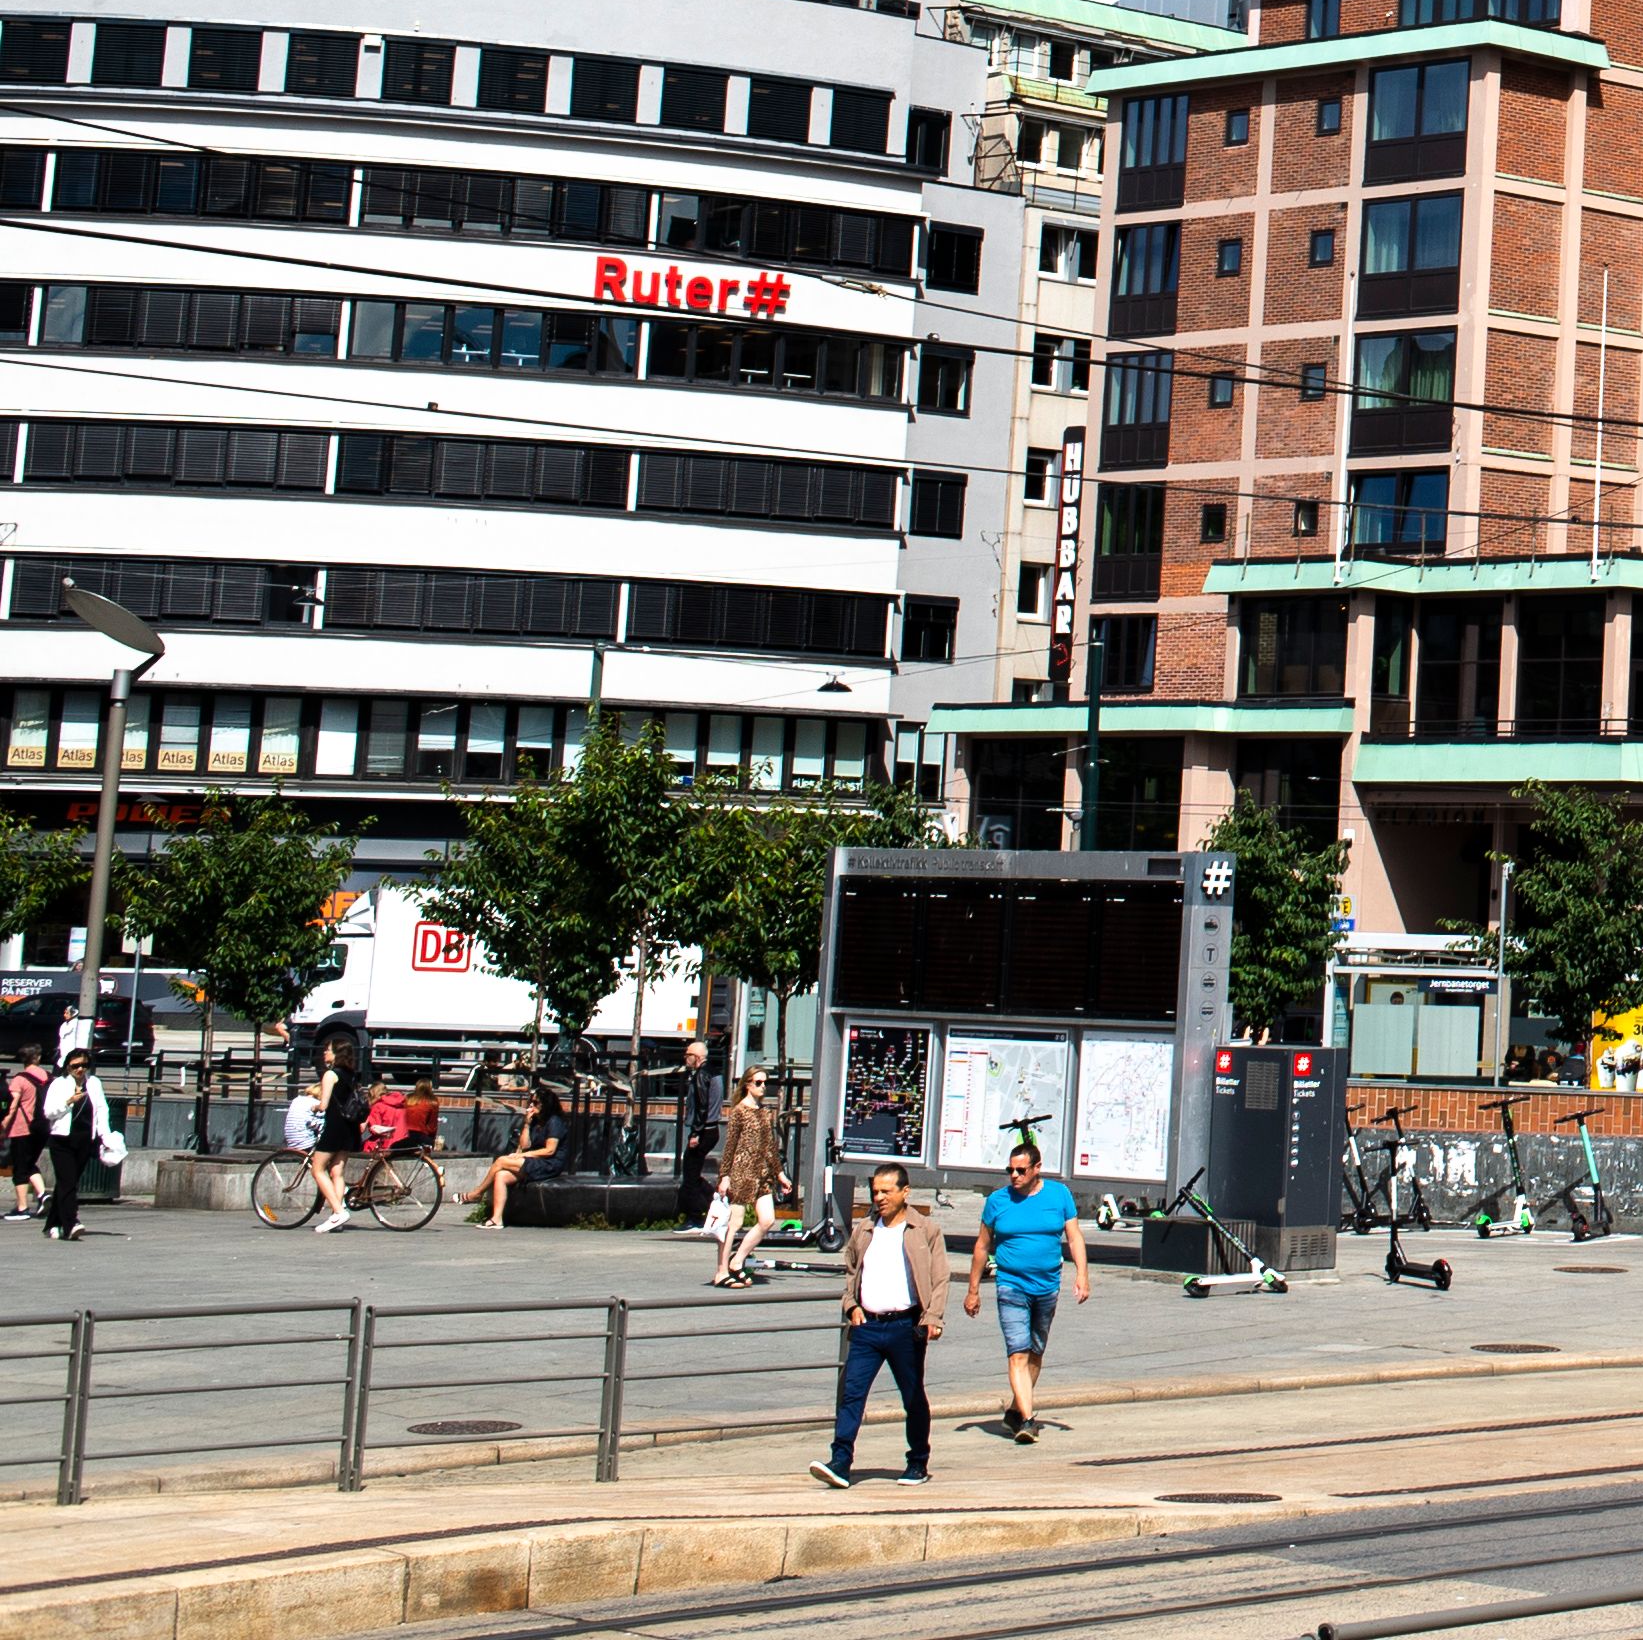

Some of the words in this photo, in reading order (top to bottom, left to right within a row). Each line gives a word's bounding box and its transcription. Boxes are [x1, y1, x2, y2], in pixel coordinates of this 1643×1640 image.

[1054, 442, 1083, 634] HUBBAR
[12, 748, 43, 760] Atlas
[61, 749, 93, 762] Atlas
[162, 752, 194, 764] Atlas
[212, 753, 244, 765] Atlas
[262, 754, 294, 767] Atlas
[420, 929, 464, 964] DB
[1, 978, 53, 988] RESERVER
[16, 987, 42, 996] NETT
